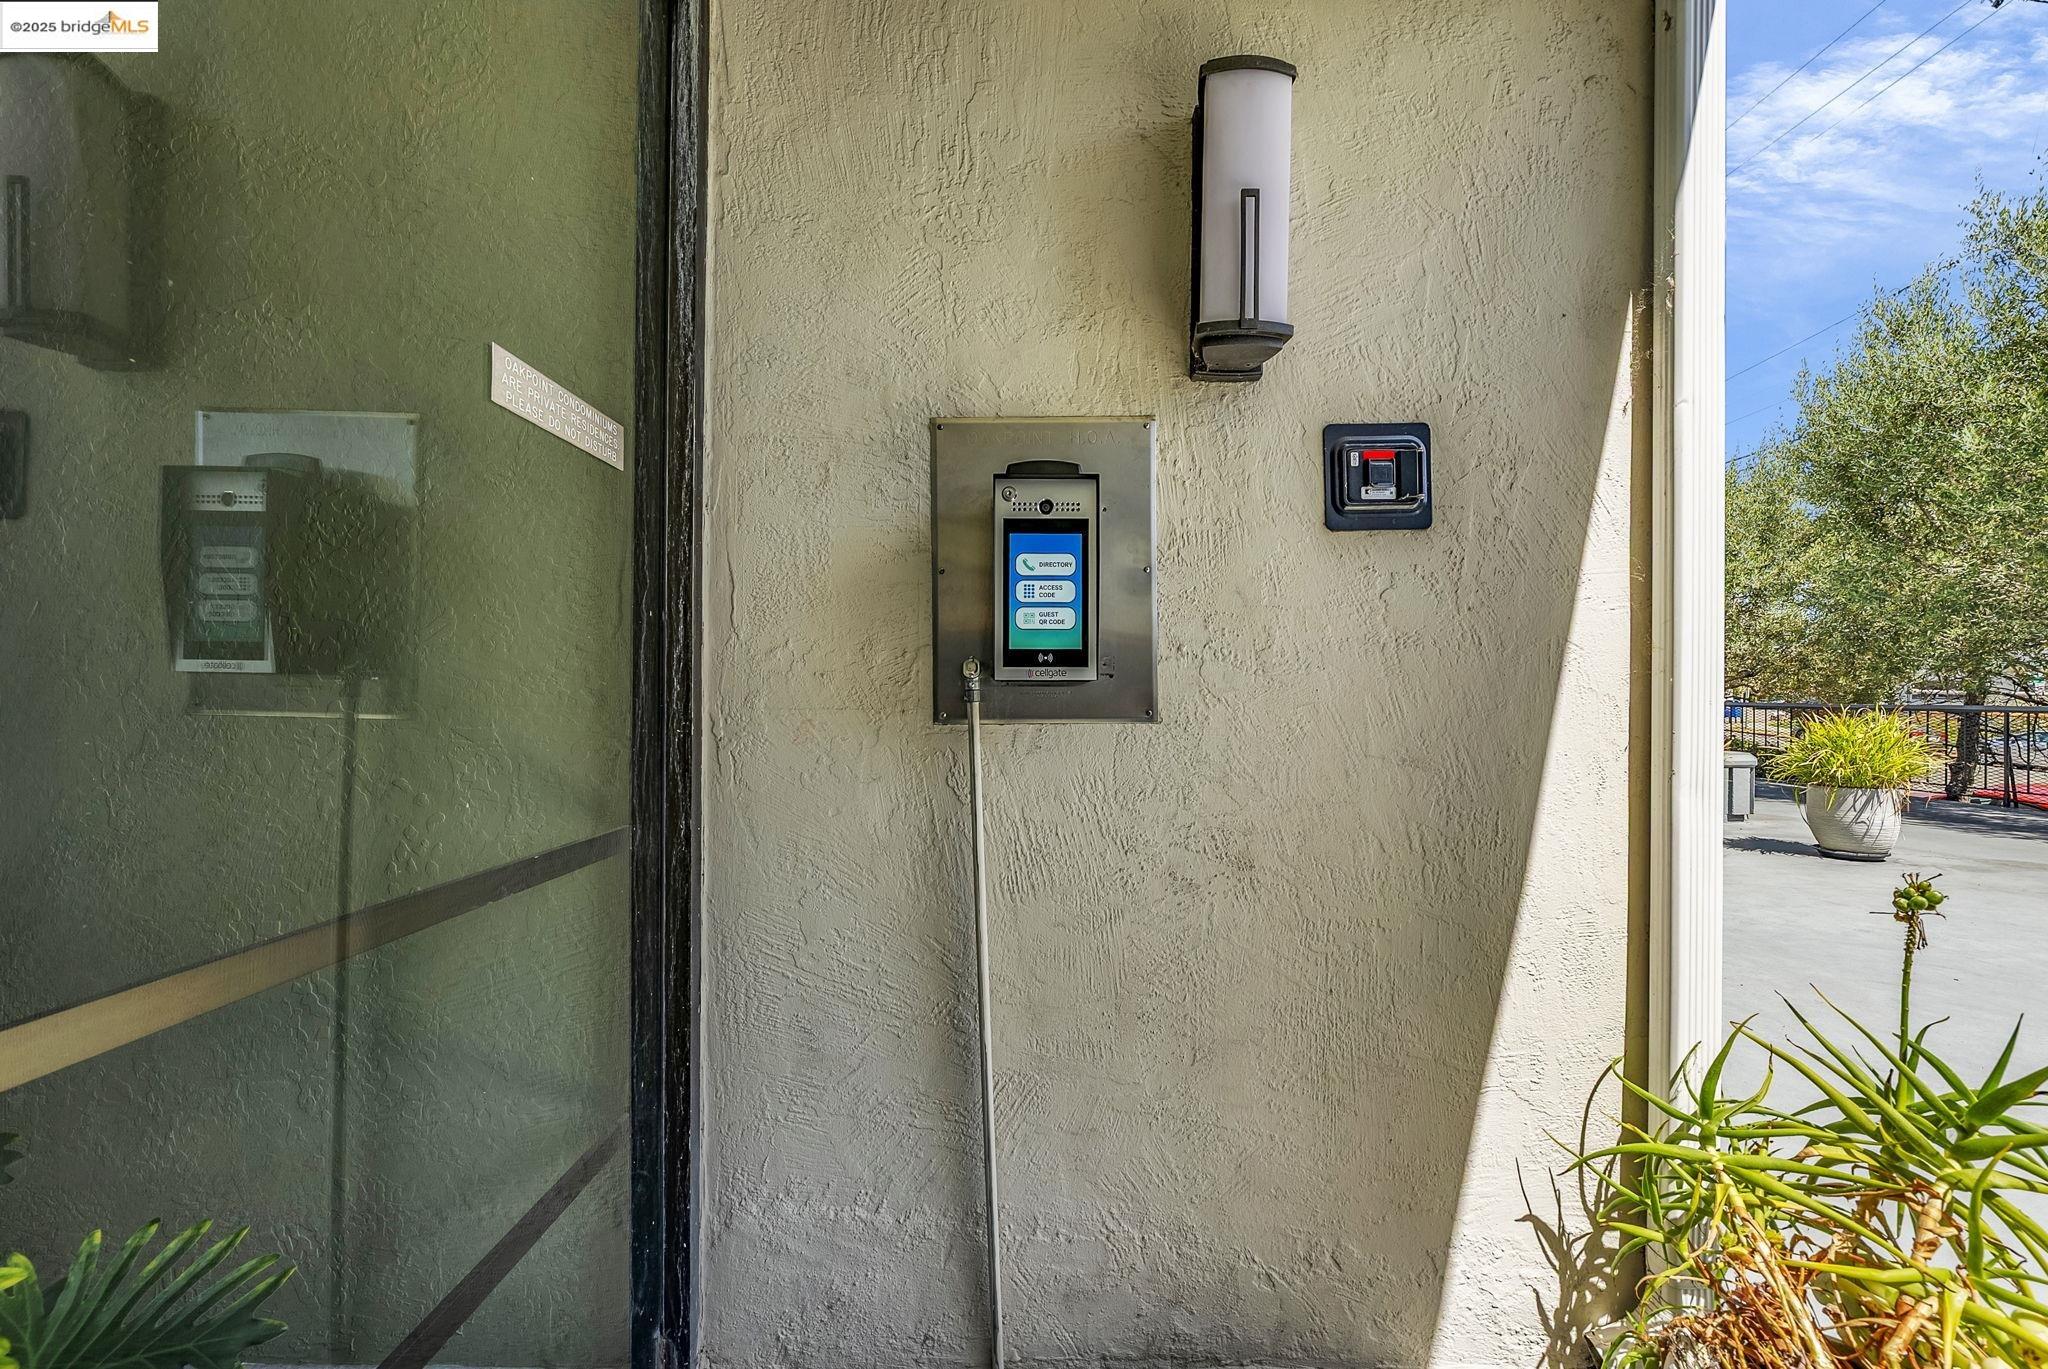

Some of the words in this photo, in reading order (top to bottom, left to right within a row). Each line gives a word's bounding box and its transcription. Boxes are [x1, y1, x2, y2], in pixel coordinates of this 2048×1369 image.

[501, 373, 522, 394] ARE
[528, 388, 567, 420] PRIVATE
[571, 414, 620, 450] RESIDENCES.
[505, 357, 555, 395] OAKPOINT
[558, 391, 618, 436] CONDOMINIUMS
[505, 391, 544, 422] PLEASE
[549, 416, 561, 431] DO
[565, 425, 581, 441] NOT
[585, 435, 617, 462] DISTURB
[1034, 668, 1067, 678] cellgate
